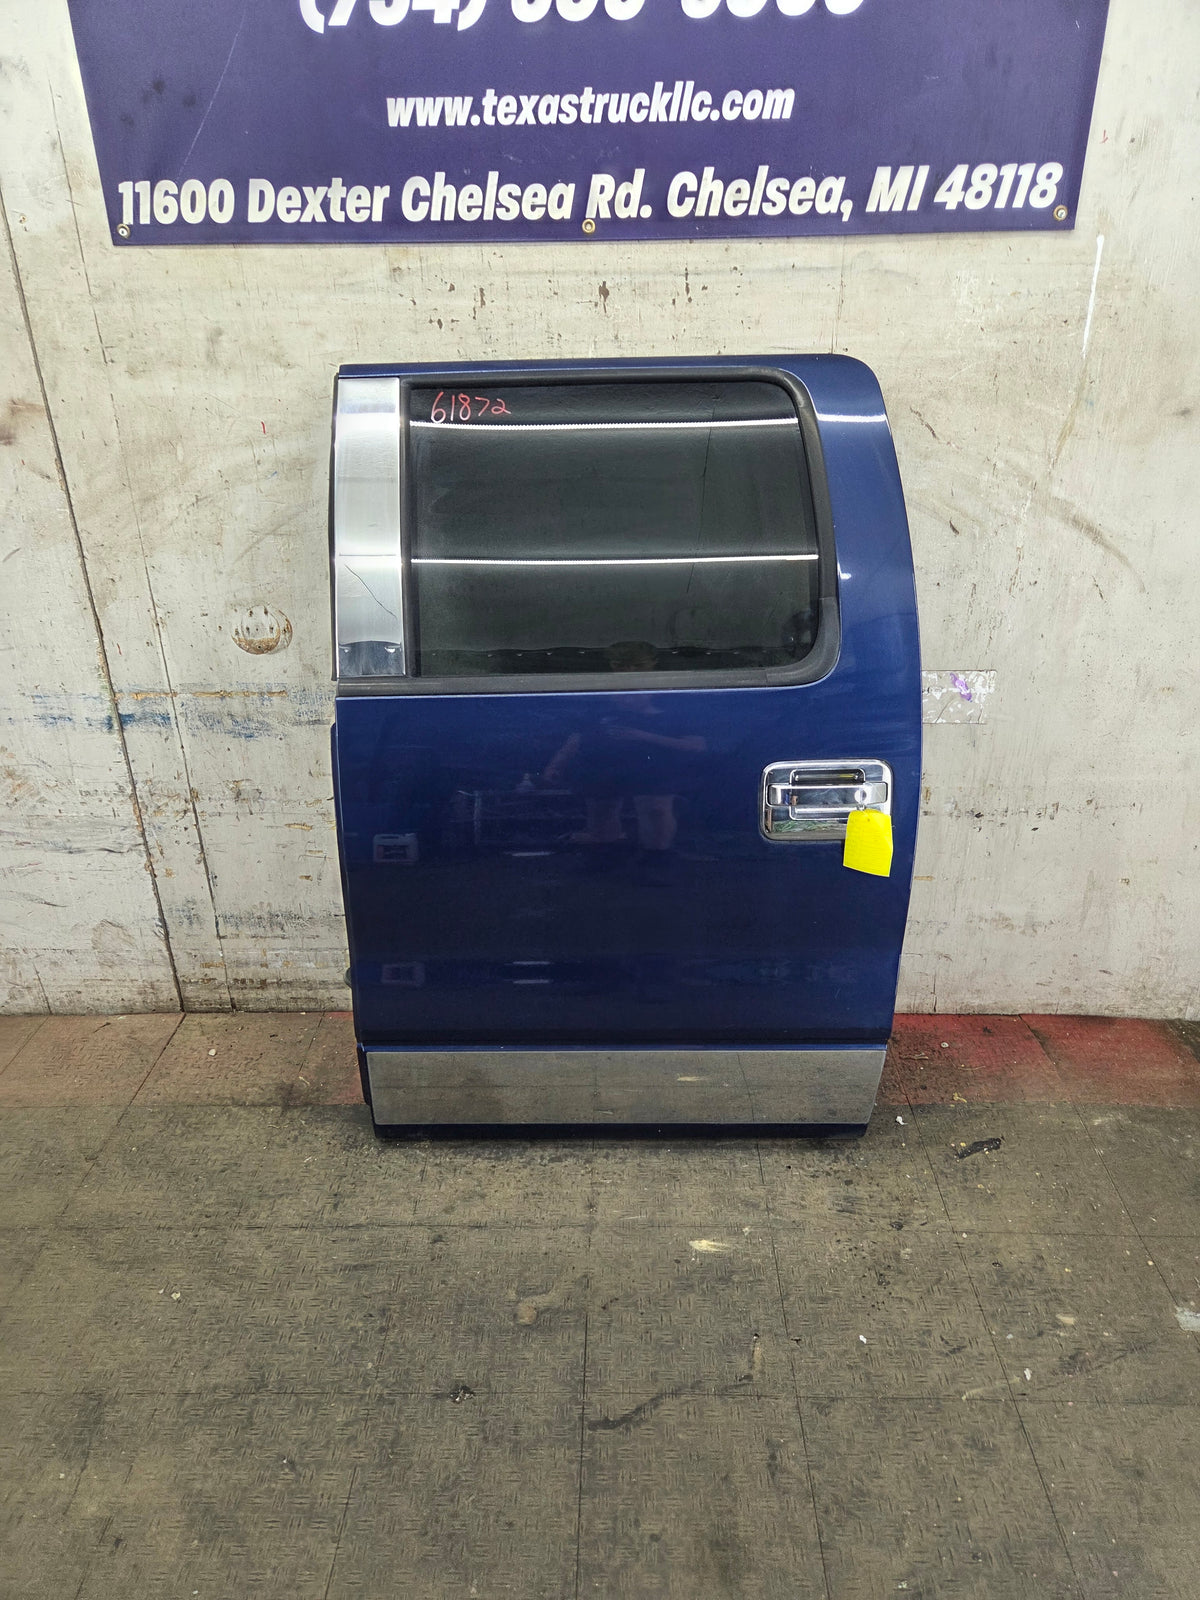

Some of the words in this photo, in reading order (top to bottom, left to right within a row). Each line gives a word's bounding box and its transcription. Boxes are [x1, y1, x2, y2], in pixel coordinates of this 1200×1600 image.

[386, 80, 796, 128] www.texastruckllc.com
[118, 179, 236, 226] 11600
[247, 177, 391, 224] Dexter
[401, 171, 576, 222] Chelsea
[585, 168, 653, 220] Rd.
[666, 164, 854, 222] Chelsea,
[865, 164, 930, 213] MI
[933, 161, 1064, 211] 48118
[430, 391, 512, 424] 61872
